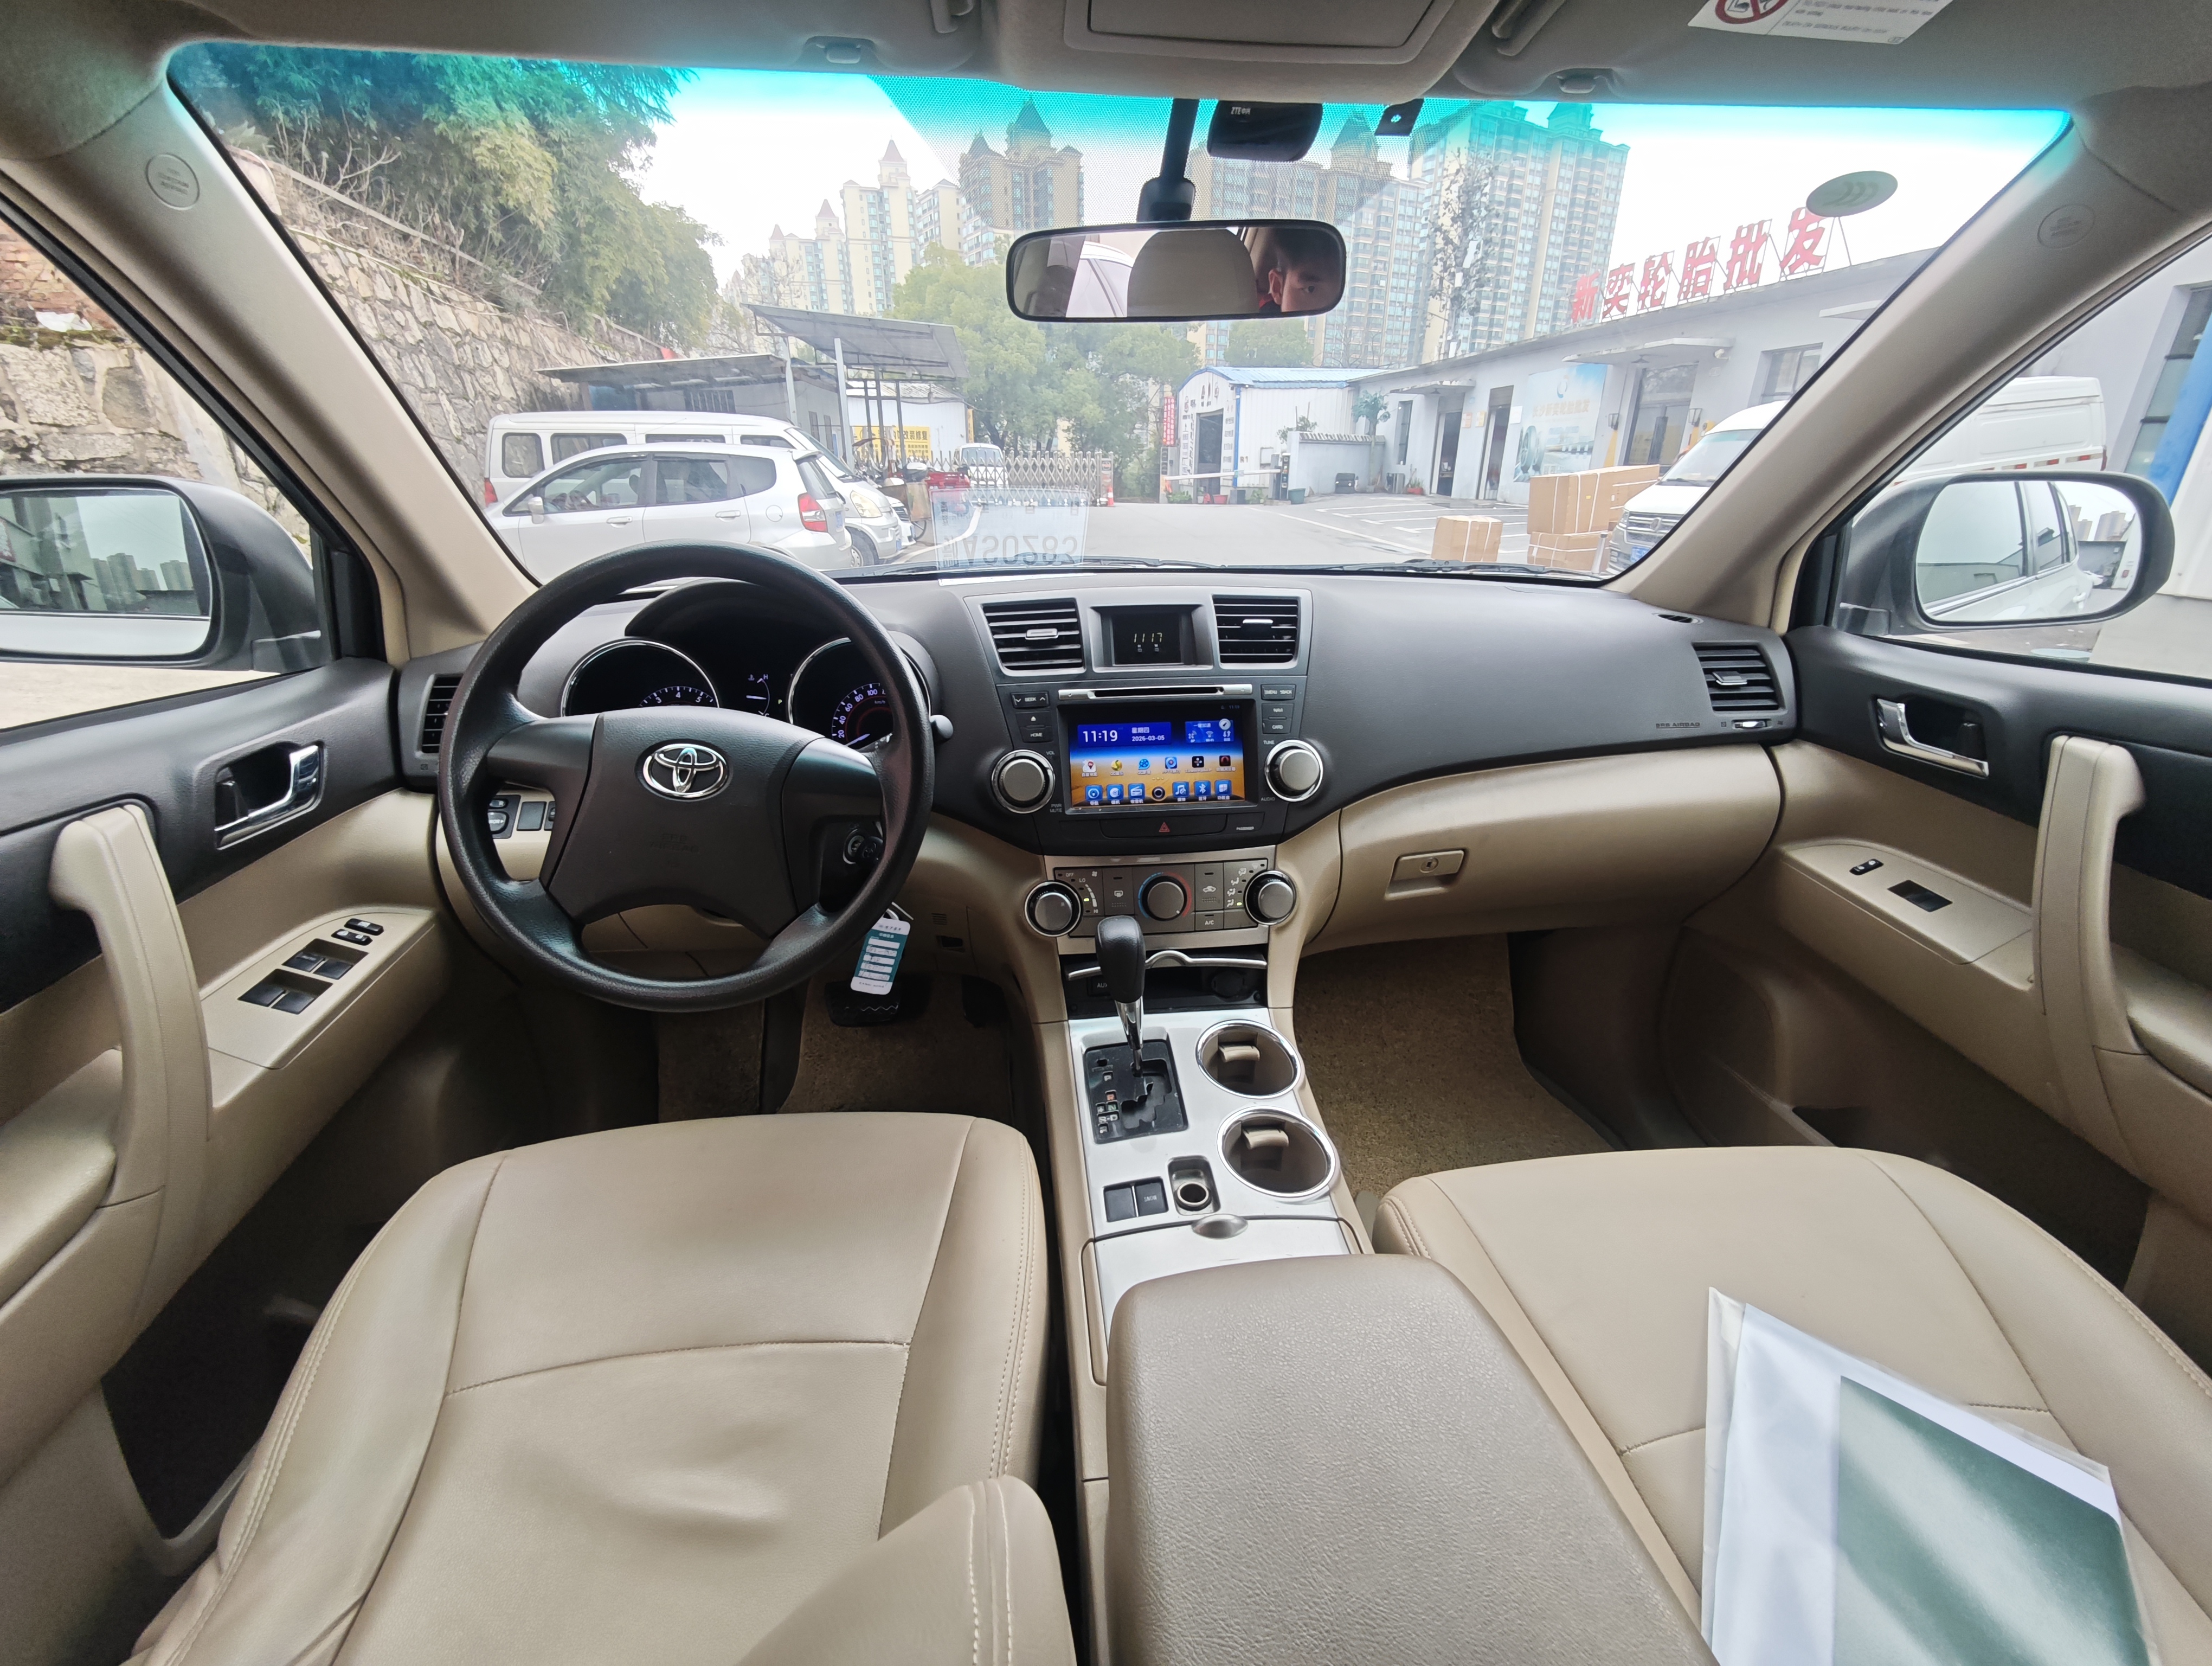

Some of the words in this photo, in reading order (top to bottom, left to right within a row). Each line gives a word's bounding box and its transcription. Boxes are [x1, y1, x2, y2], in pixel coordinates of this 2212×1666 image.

[1572, 207, 1827, 323] 新奕轮胎批发
[655, 696, 662, 704] 3
[854, 693, 864, 702] 80
[844, 703, 853, 713] 60
[838, 715, 847, 725] 40
[837, 729, 845, 739] 20
[1083, 729, 1118, 743] 11:19
